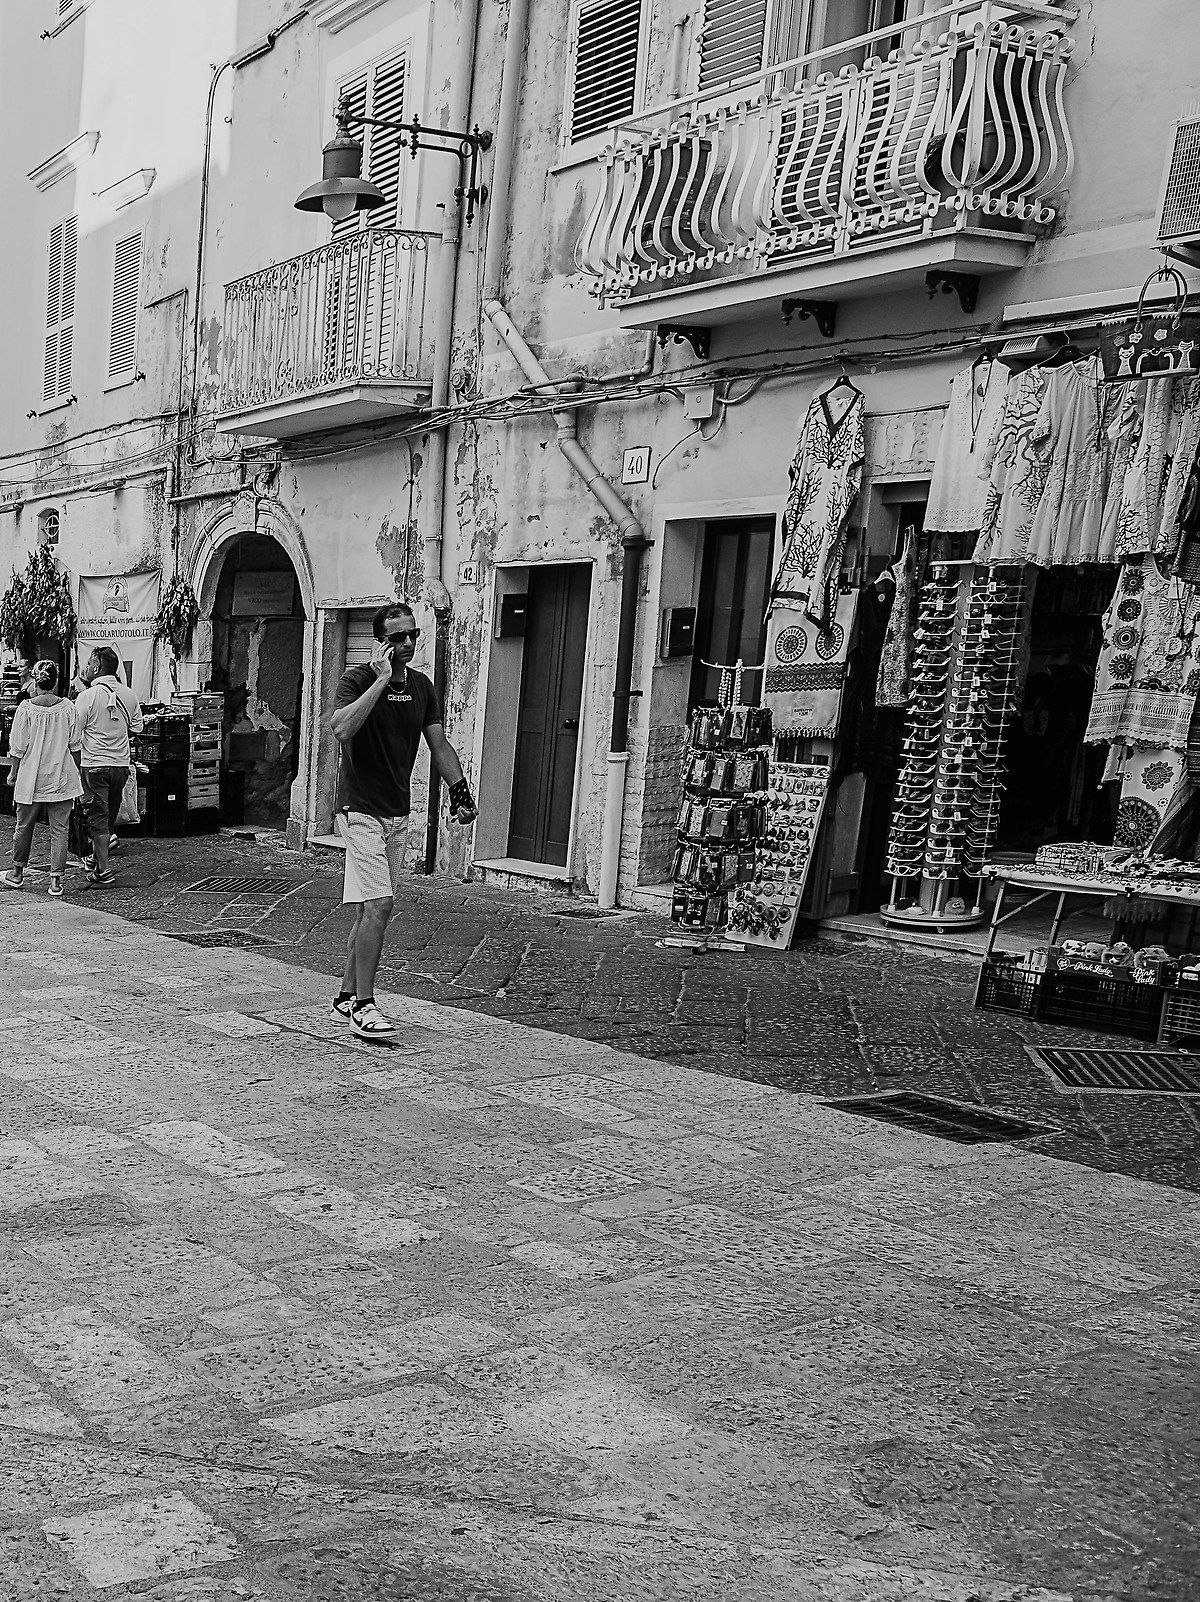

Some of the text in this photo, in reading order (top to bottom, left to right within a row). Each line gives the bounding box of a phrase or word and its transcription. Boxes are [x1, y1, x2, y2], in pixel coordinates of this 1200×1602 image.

[627, 455, 643, 475] 40
[463, 566, 473, 581] 42
[387, 694, 413, 702] Kappa
[1069, 961, 1114, 978] Pink Lady
[1130, 966, 1156, 978] Pink
[1133, 974, 1156, 985] Lady
